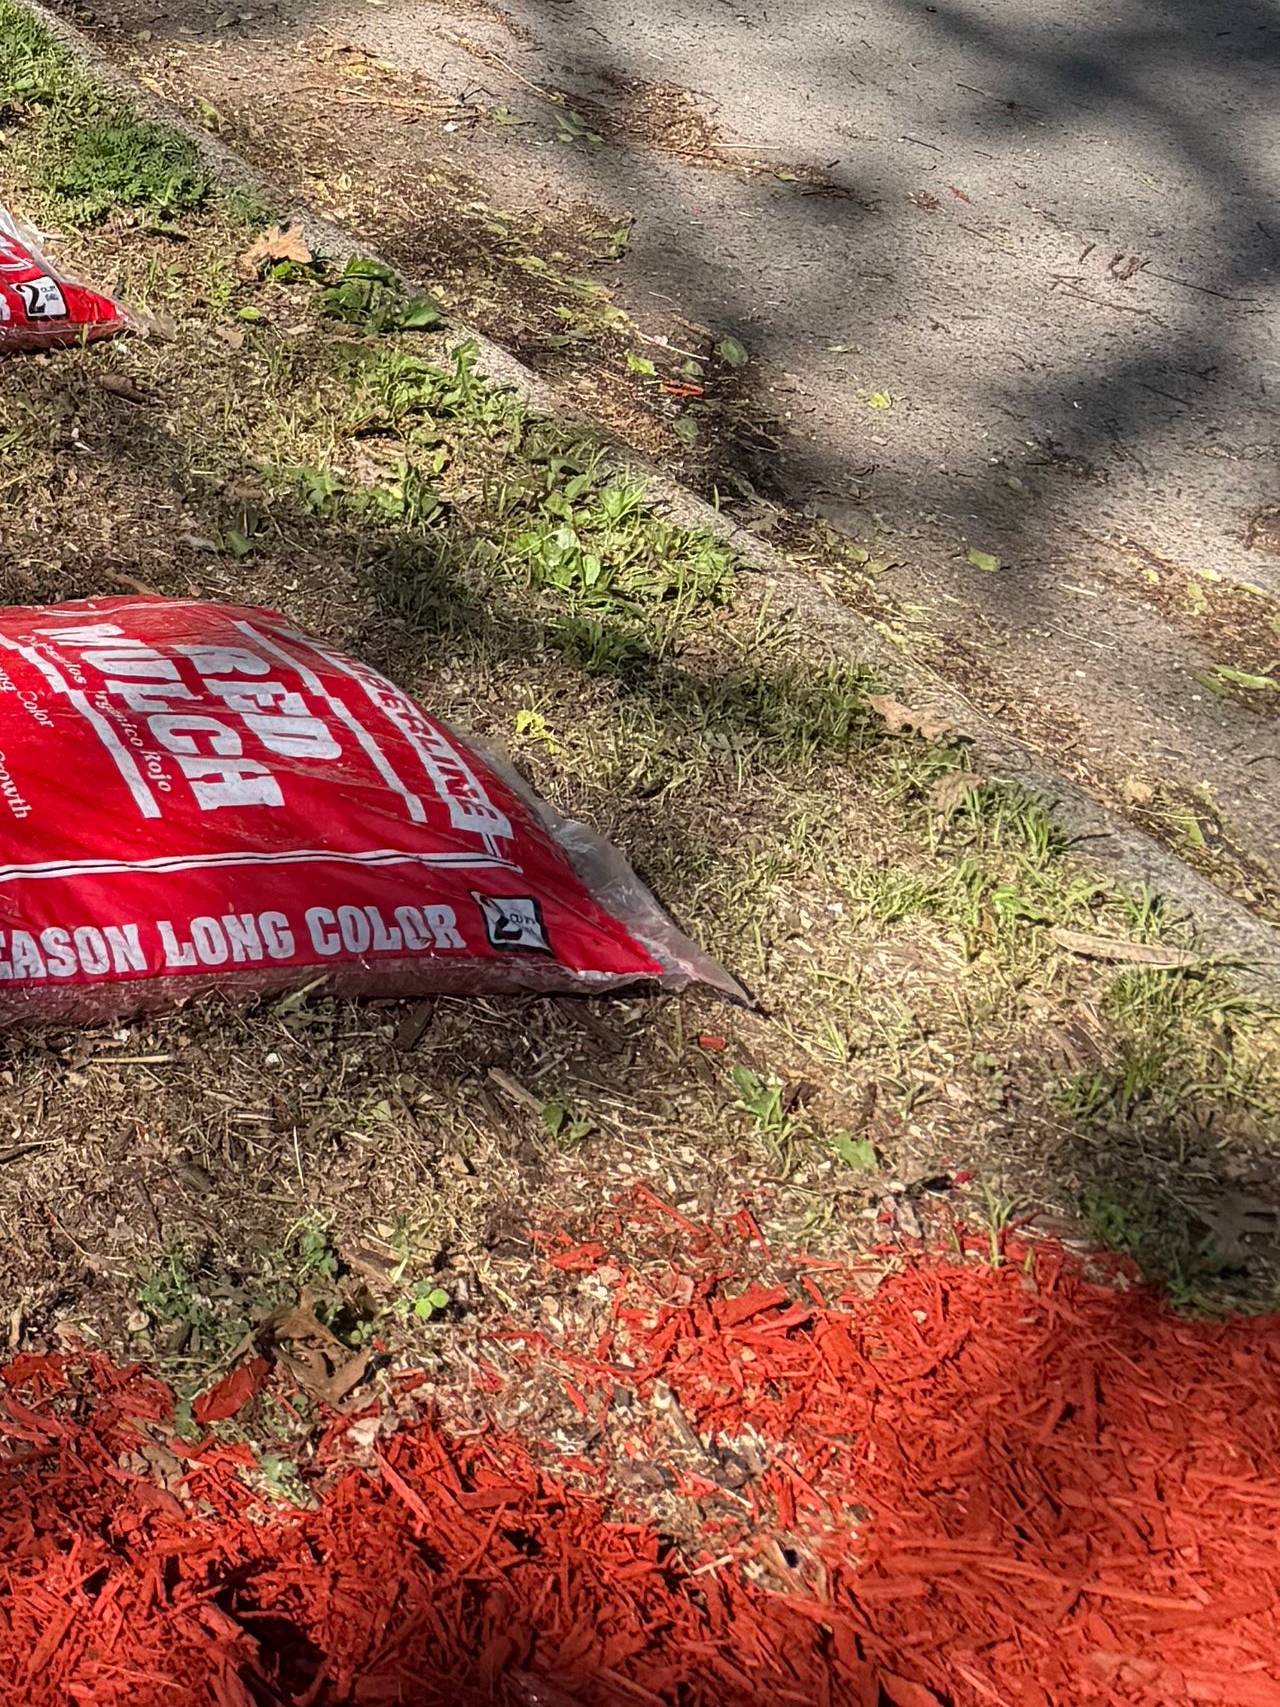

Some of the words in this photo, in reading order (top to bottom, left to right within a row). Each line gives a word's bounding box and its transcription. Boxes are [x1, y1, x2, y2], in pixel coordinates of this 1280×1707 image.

[16, 282, 48, 315] 2
[16, 689, 56, 730] Color
[31, 621, 286, 812] MULCH
[93, 690, 145, 748] rganico
[140, 749, 174, 793] Rojo
[169, 644, 343, 761] RED
[157, 909, 298, 969] LONG
[305, 904, 467, 957] COLOR
